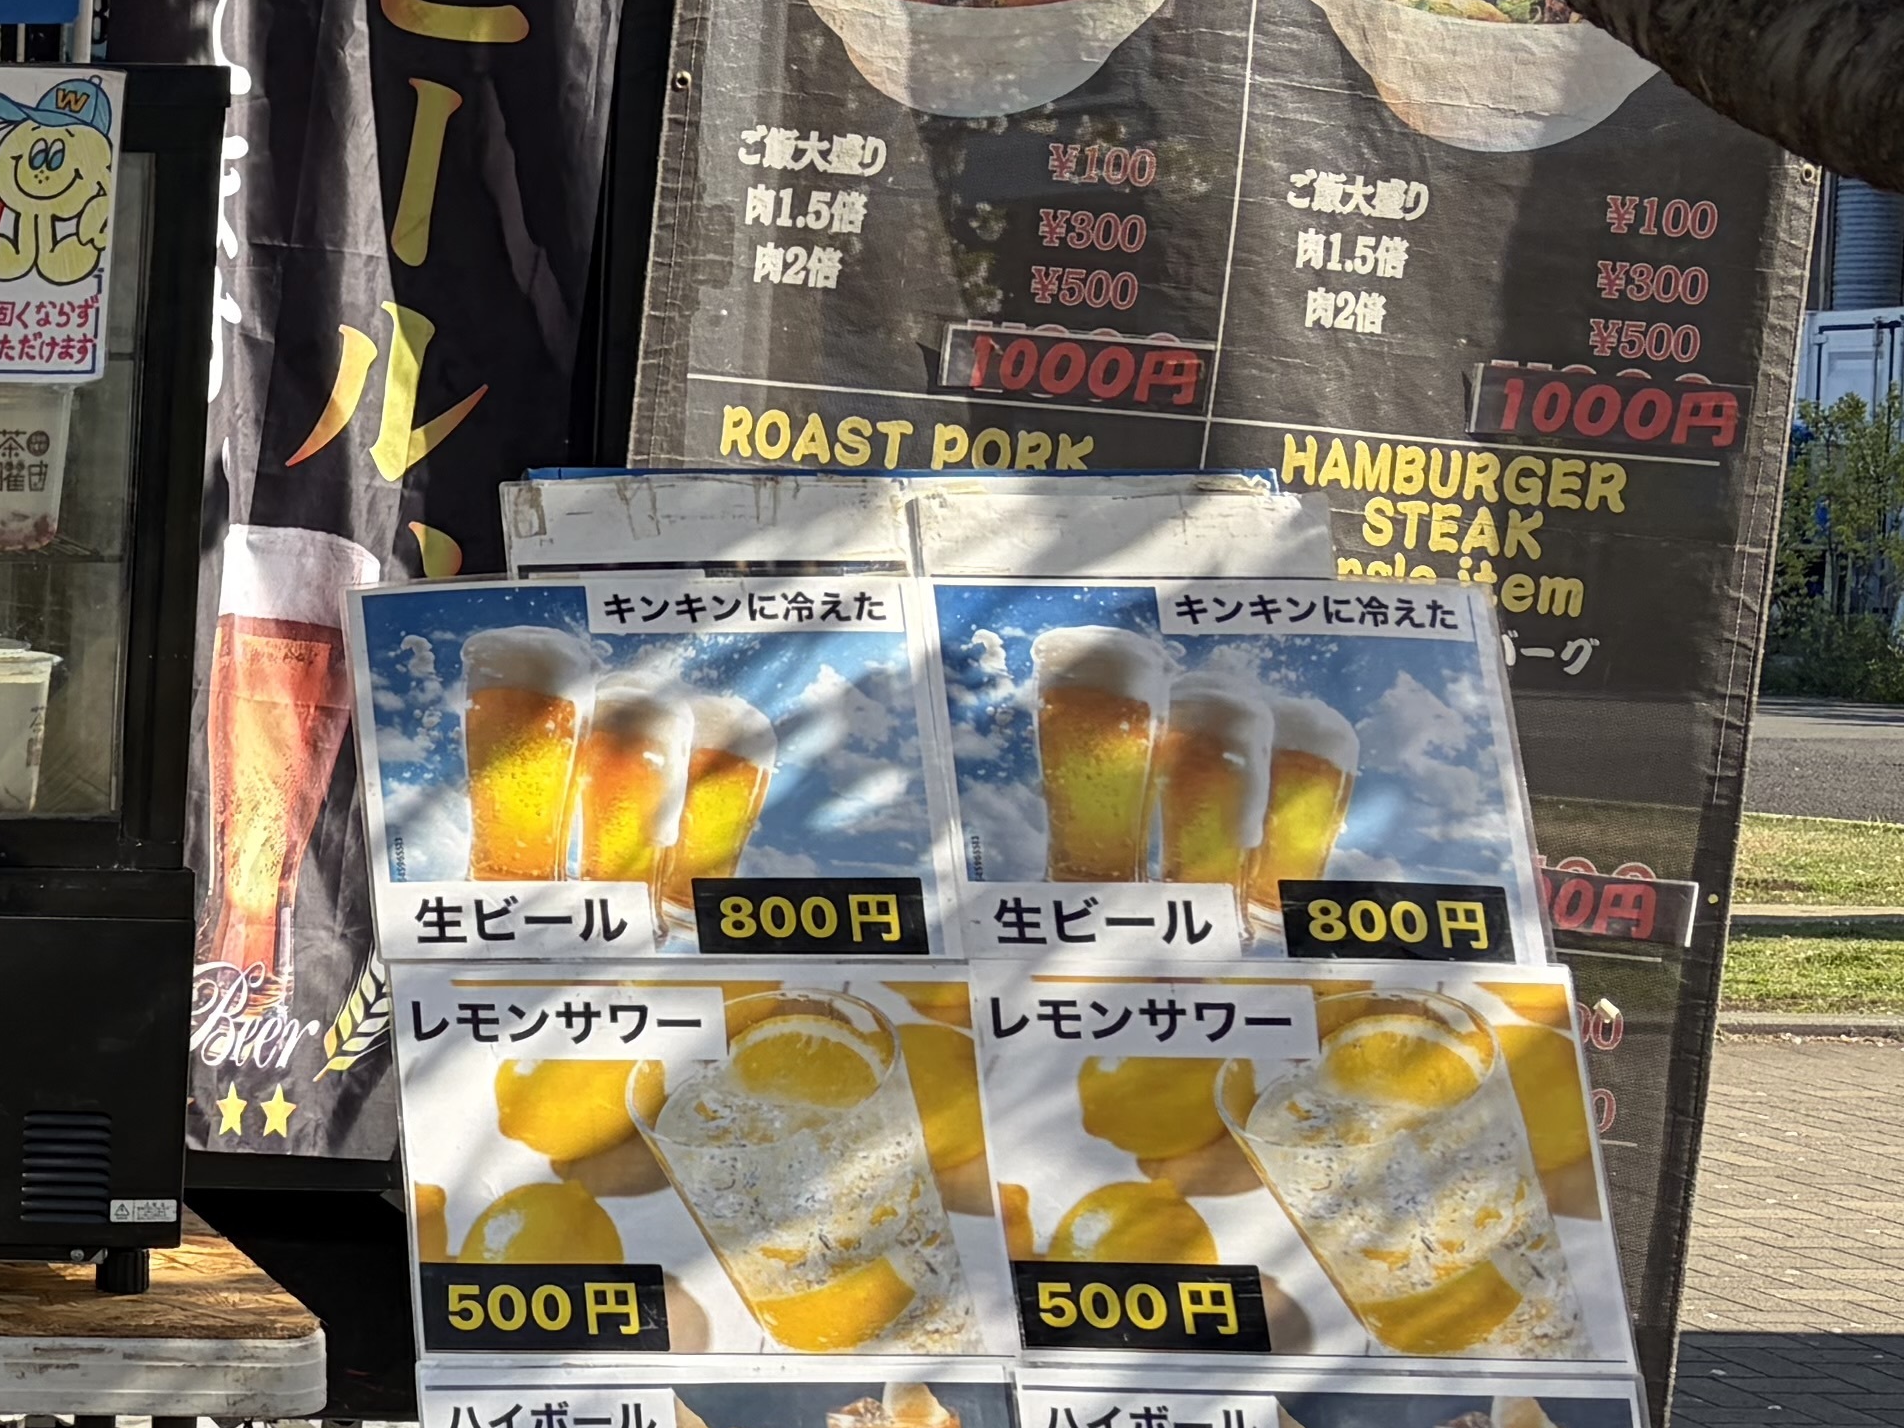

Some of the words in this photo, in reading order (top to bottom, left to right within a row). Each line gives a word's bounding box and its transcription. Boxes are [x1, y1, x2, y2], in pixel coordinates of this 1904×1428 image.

[55, 87, 88, 112] W
[738, 125, 888, 178] ご飯大盛り
[1048, 142, 1157, 187] ¥100
[744, 184, 868, 235] 肉1.5倍
[1286, 168, 1430, 222] ご飯大盛り
[1605, 194, 1719, 240] ¥100
[1039, 208, 1147, 253] ¥300
[1295, 227, 1410, 280] 肉1.5倍
[753, 241, 843, 290] 肉2倍
[1030, 265, 1139, 310] ¥500
[1597, 260, 1710, 306] ¥300
[1304, 286, 1387, 335] 肉2倍
[1589, 318, 1701, 364] ¥500
[971, 333, 1200, 406] 1000円
[720, 404, 912, 470] ROAST
[932, 423, 1095, 471] PORK
[1497, 377, 1740, 448] 1000円
[1280, 434, 1628, 515] HAMBURGER
[1361, 496, 1545, 560] STEAK
[603, 591, 888, 624] キンキンに冷えた
[1174, 593, 1459, 630] キンキンに冷えた
[414, 895, 628, 946] 生ビール
[718, 892, 902, 943] 800円
[993, 896, 1213, 947] 生ビール
[1307, 898, 1490, 950] 800円
[411, 999, 703, 1044] レモンサワー
[991, 995, 1292, 1041] レモンサワー
[446, 1280, 642, 1337] 500円
[1037, 1279, 1239, 1336] 500円
